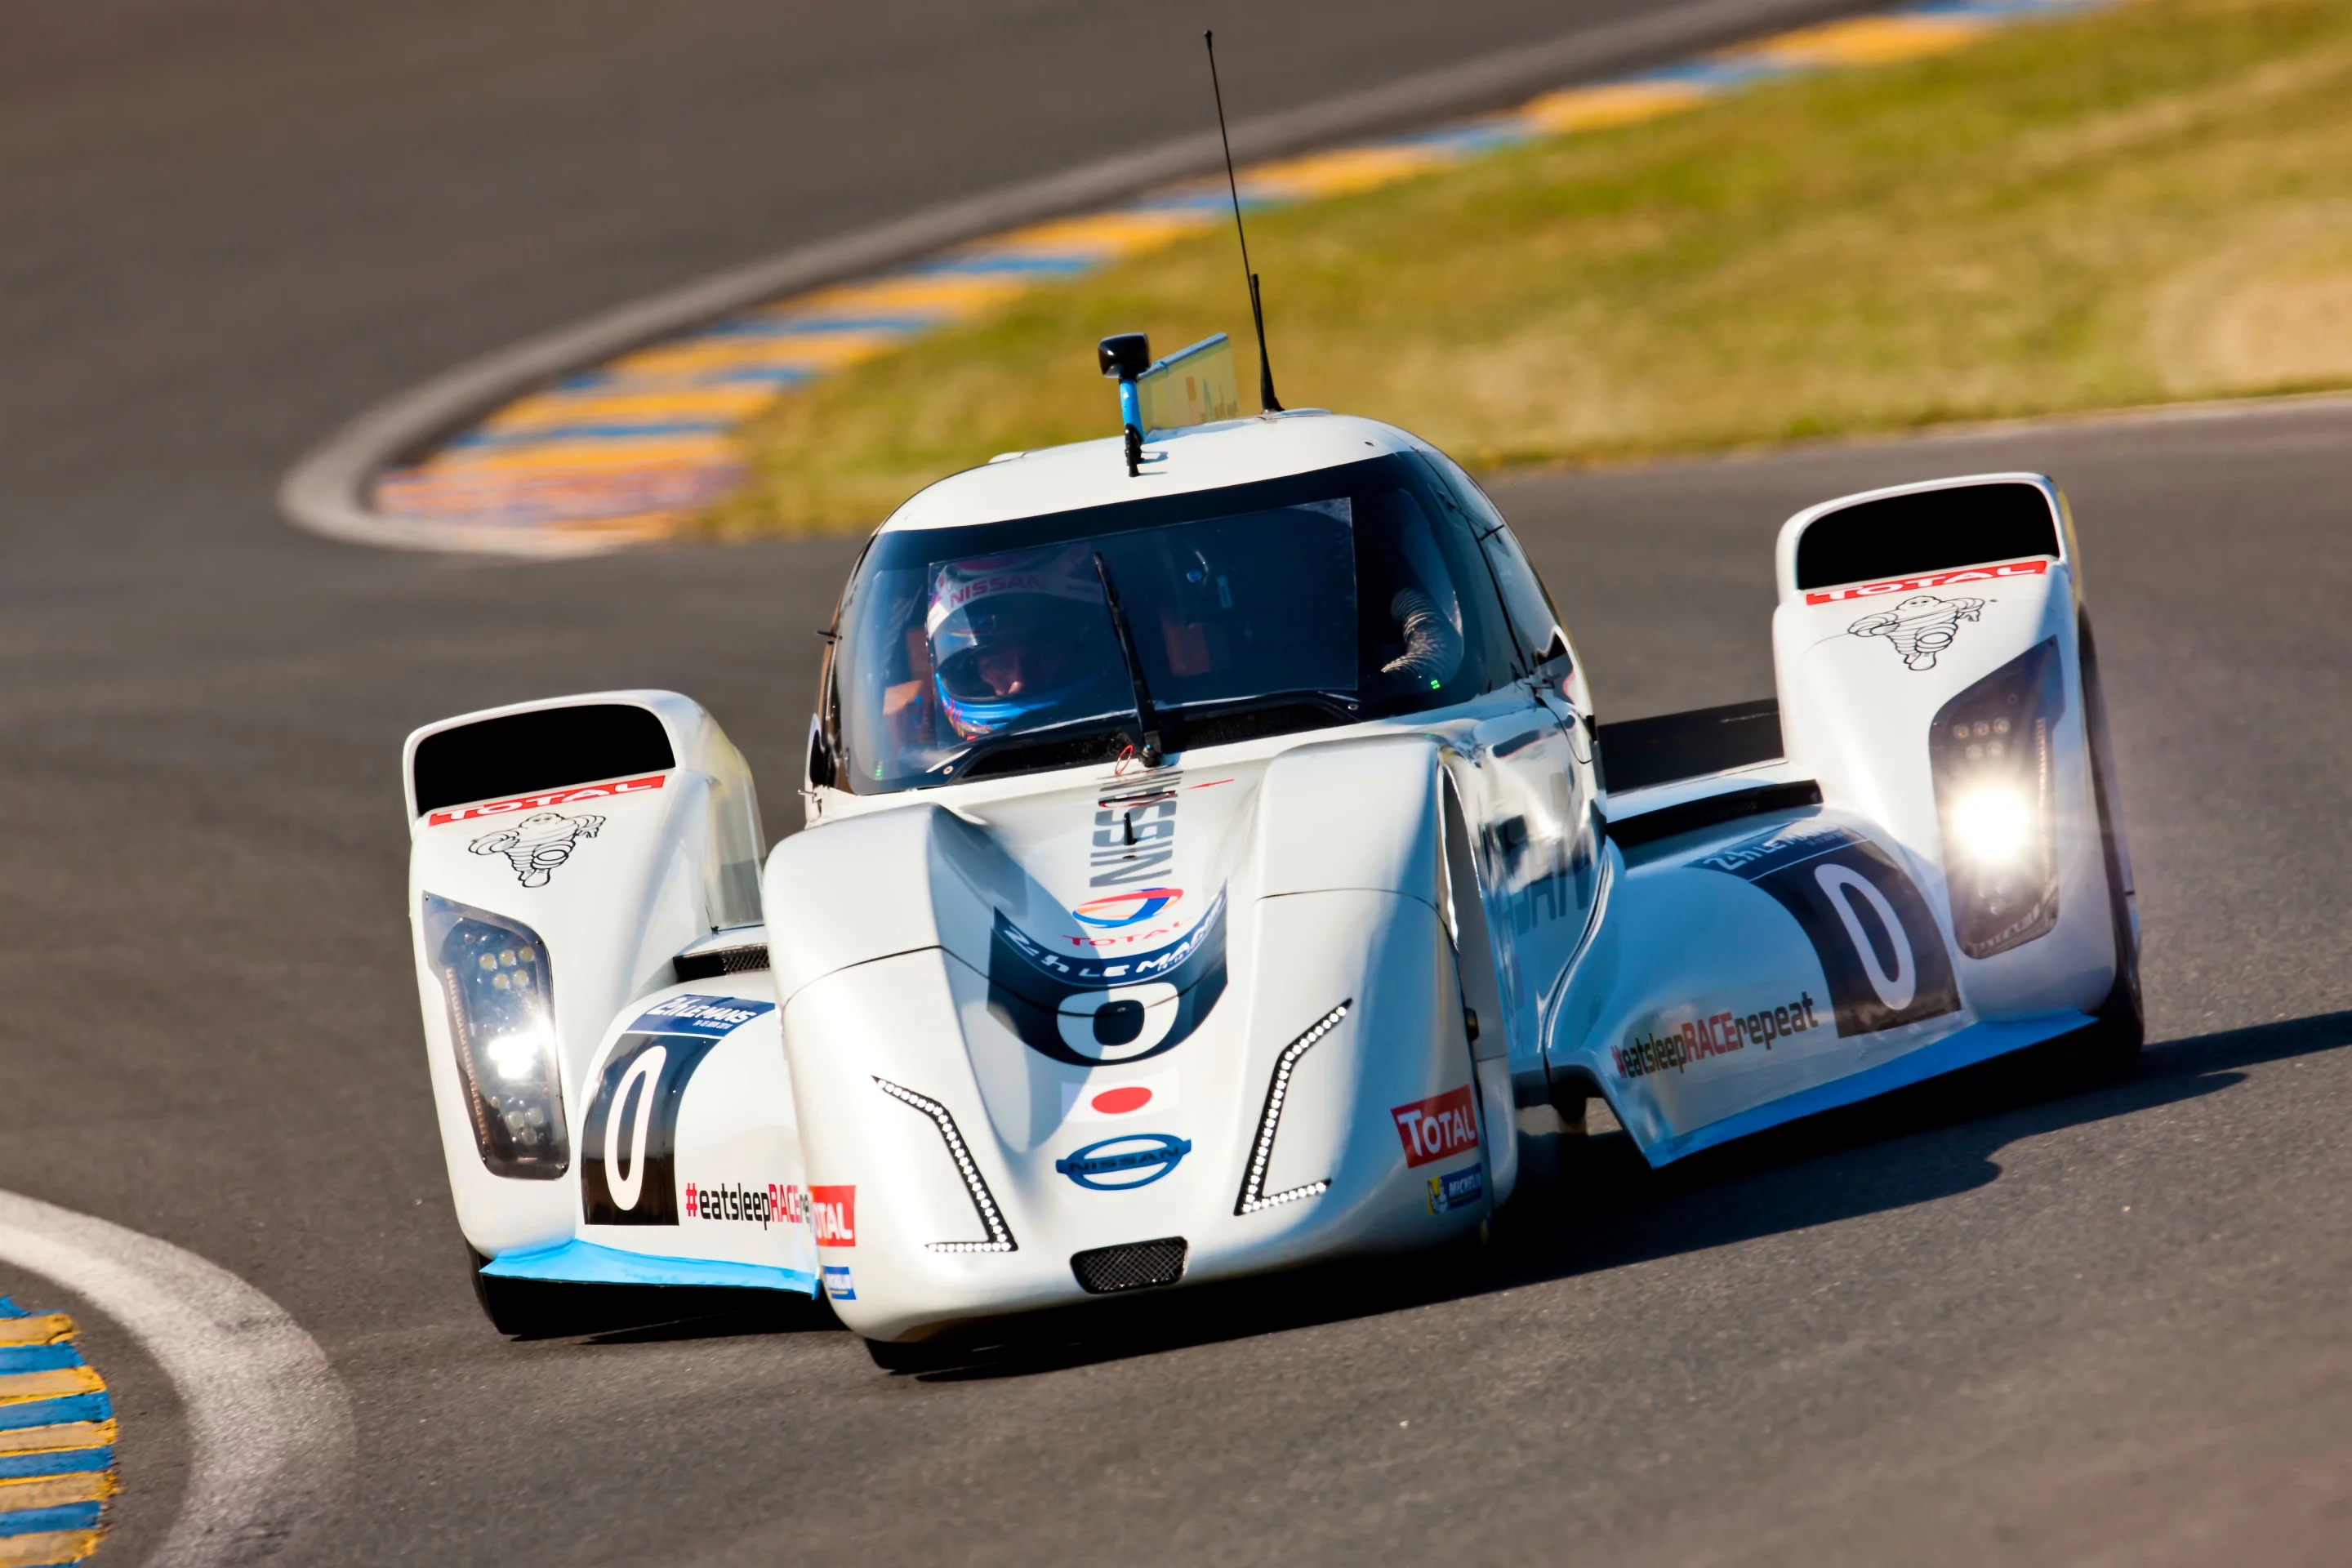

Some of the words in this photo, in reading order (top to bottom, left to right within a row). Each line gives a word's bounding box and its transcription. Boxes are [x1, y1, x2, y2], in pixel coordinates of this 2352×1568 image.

[950, 575, 1047, 608] NISSAN
[1815, 566, 2037, 600] TOTAL
[436, 782, 653, 820] TOTAL
[1061, 916, 1194, 946] TOTAL
[1815, 863, 1917, 1011] 0
[1057, 982, 1179, 1061] 0
[1610, 991, 1820, 1079] #eatsleepRACErepeat
[604, 1045, 666, 1211] 0
[1396, 1105, 1476, 1157] TOTAL
[1069, 1146, 1179, 1172] NISSAN
